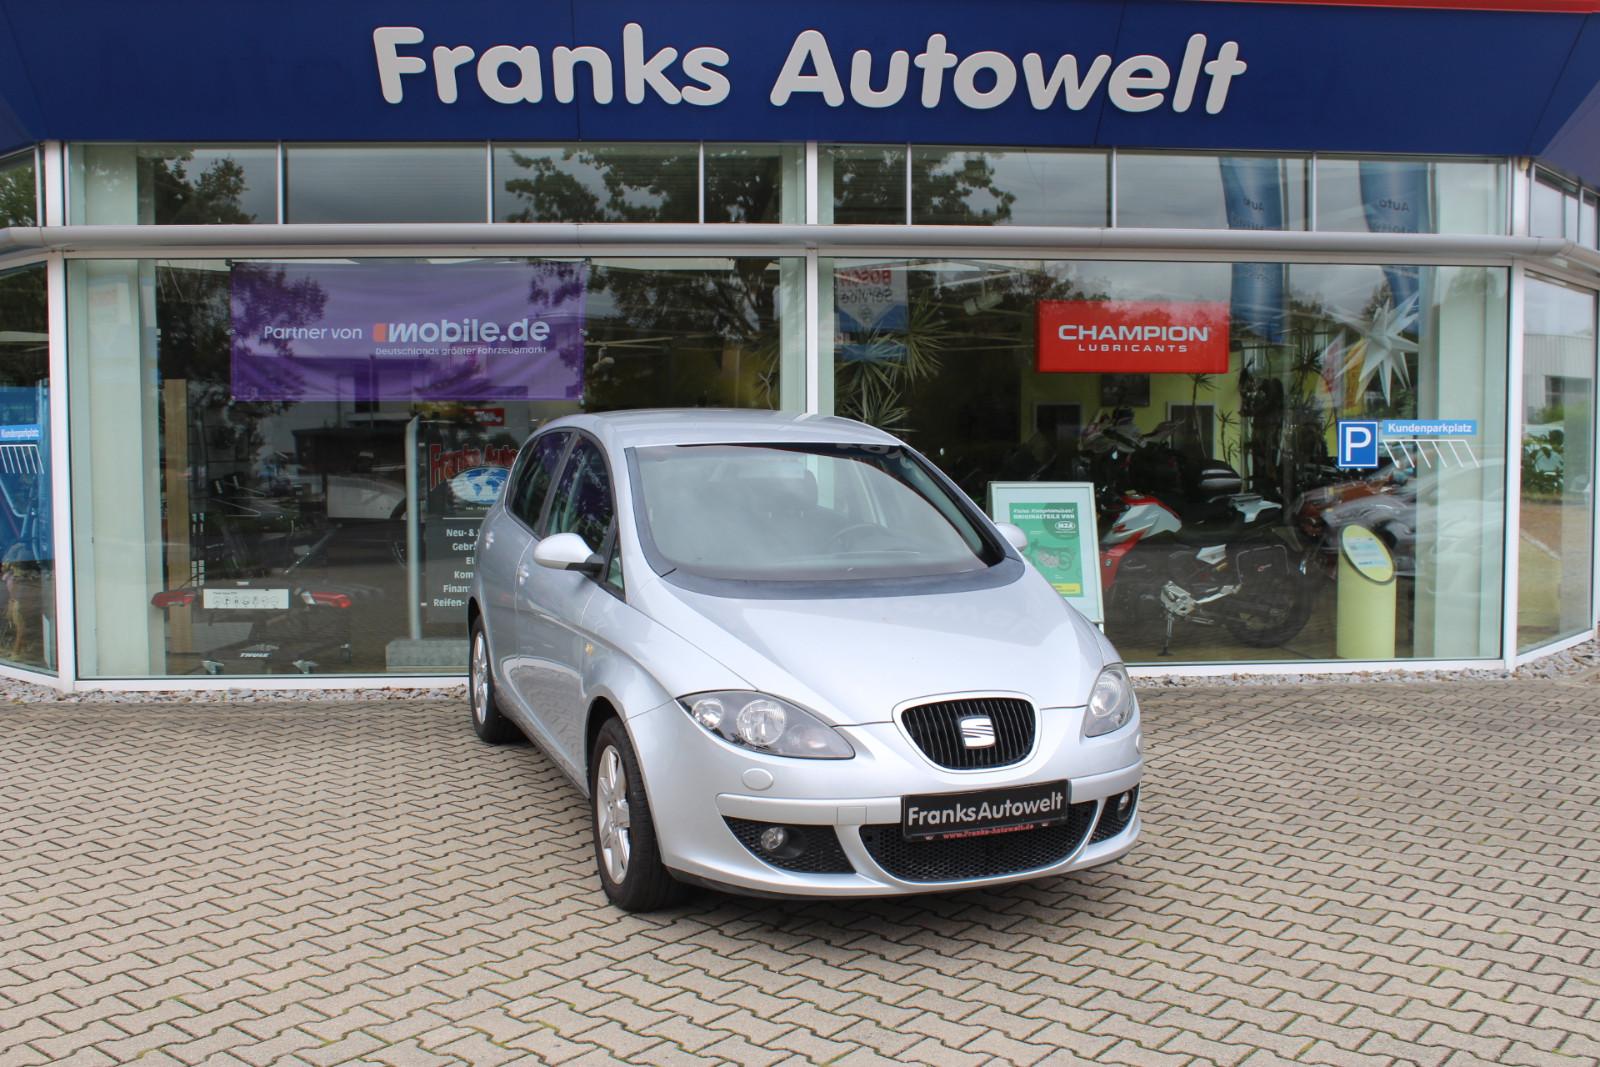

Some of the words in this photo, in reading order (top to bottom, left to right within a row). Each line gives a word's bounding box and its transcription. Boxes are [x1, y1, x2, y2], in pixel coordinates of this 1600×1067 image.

[373, 22, 731, 106] Franks
[769, 29, 1247, 115] Autowelt
[264, 325, 328, 339] Partner
[330, 327, 362, 339] von
[388, 318, 550, 343] mobile.de
[1058, 324, 1209, 341] CHAMPION
[375, 346, 439, 355] Deutschlands
[477, 345, 546, 355] Fahrzeugmarkt
[1078, 344, 1188, 352] LUBRICANTS
[1388, 423, 1473, 435] Kundenparkplatz
[1345, 426, 1372, 462] P
[446, 528, 467, 537] Neu-
[908, 791, 1064, 827] FranksAutowelt
